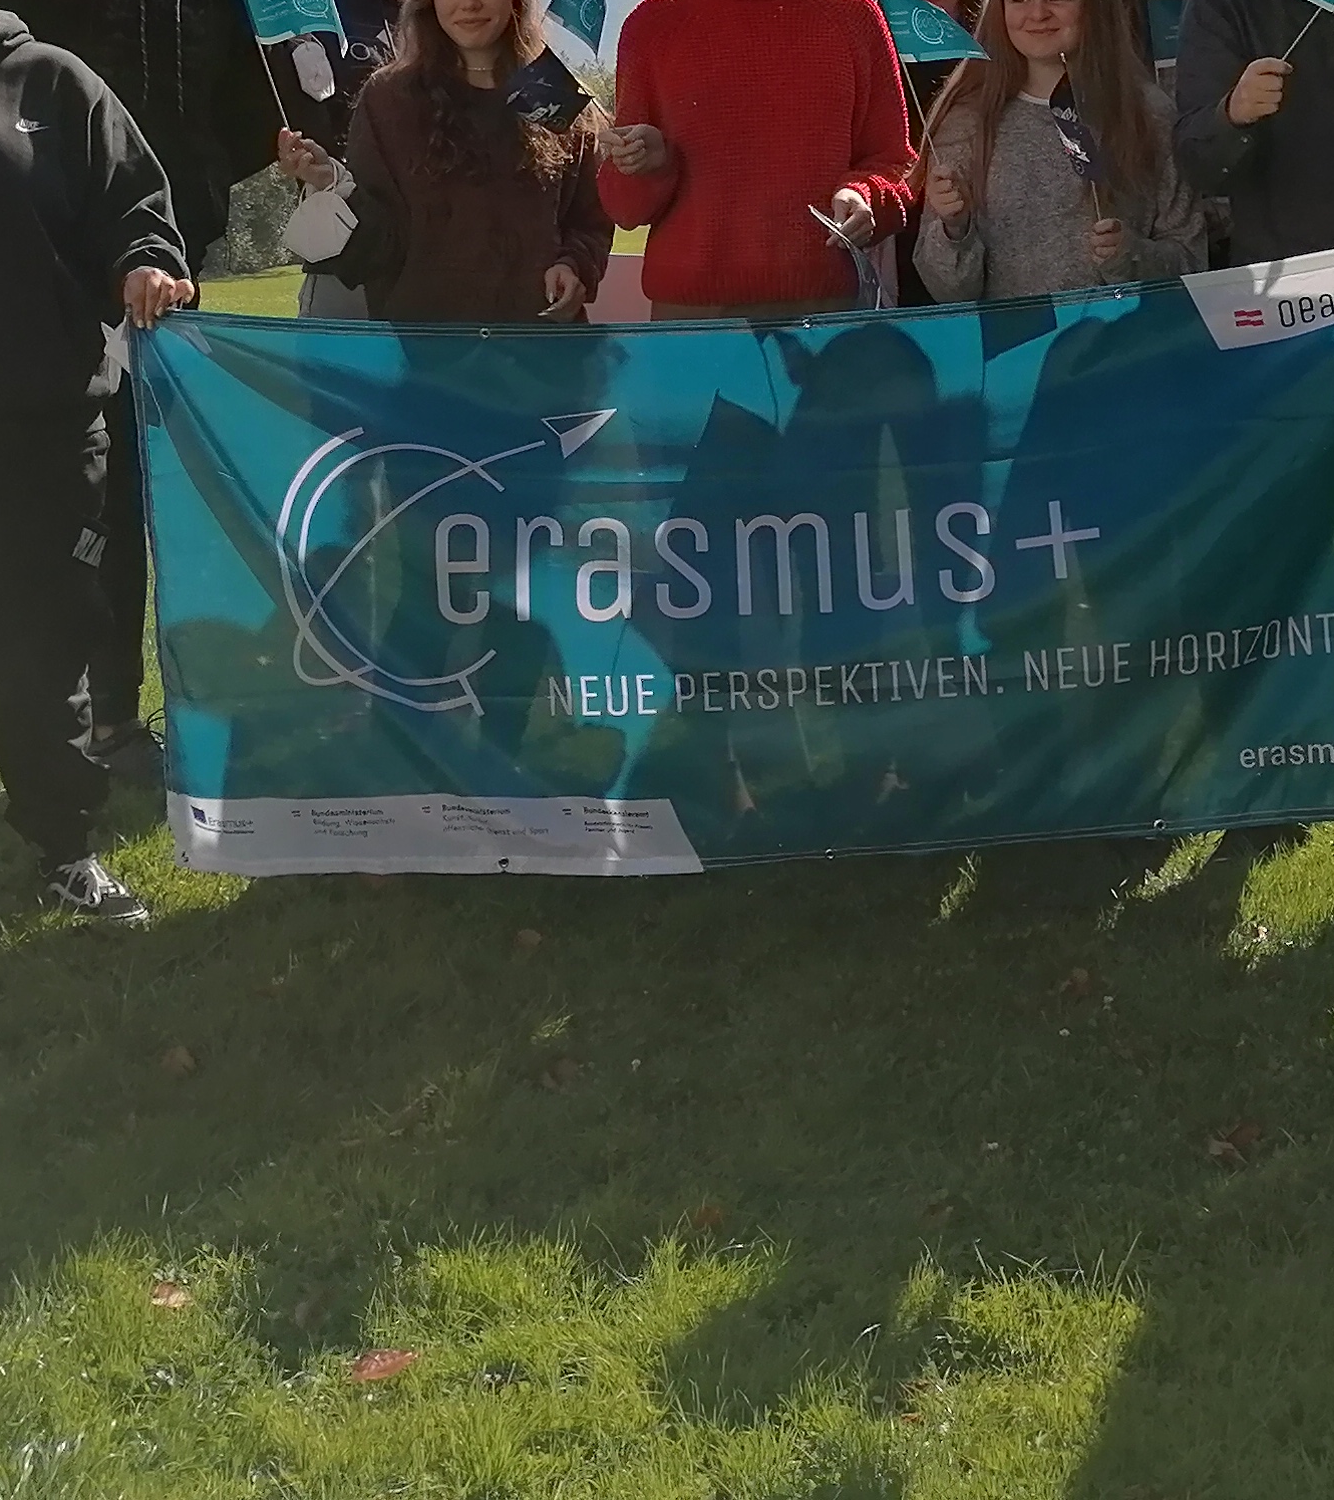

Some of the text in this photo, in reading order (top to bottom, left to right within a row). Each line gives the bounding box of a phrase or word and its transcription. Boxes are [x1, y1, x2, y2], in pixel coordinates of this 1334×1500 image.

[435, 500, 1100, 624] erasmus+
[547, 674, 657, 717] NEUE
[674, 655, 1004, 713] PERSPEKTIVEN.
[1023, 643, 1131, 691] NEUE
